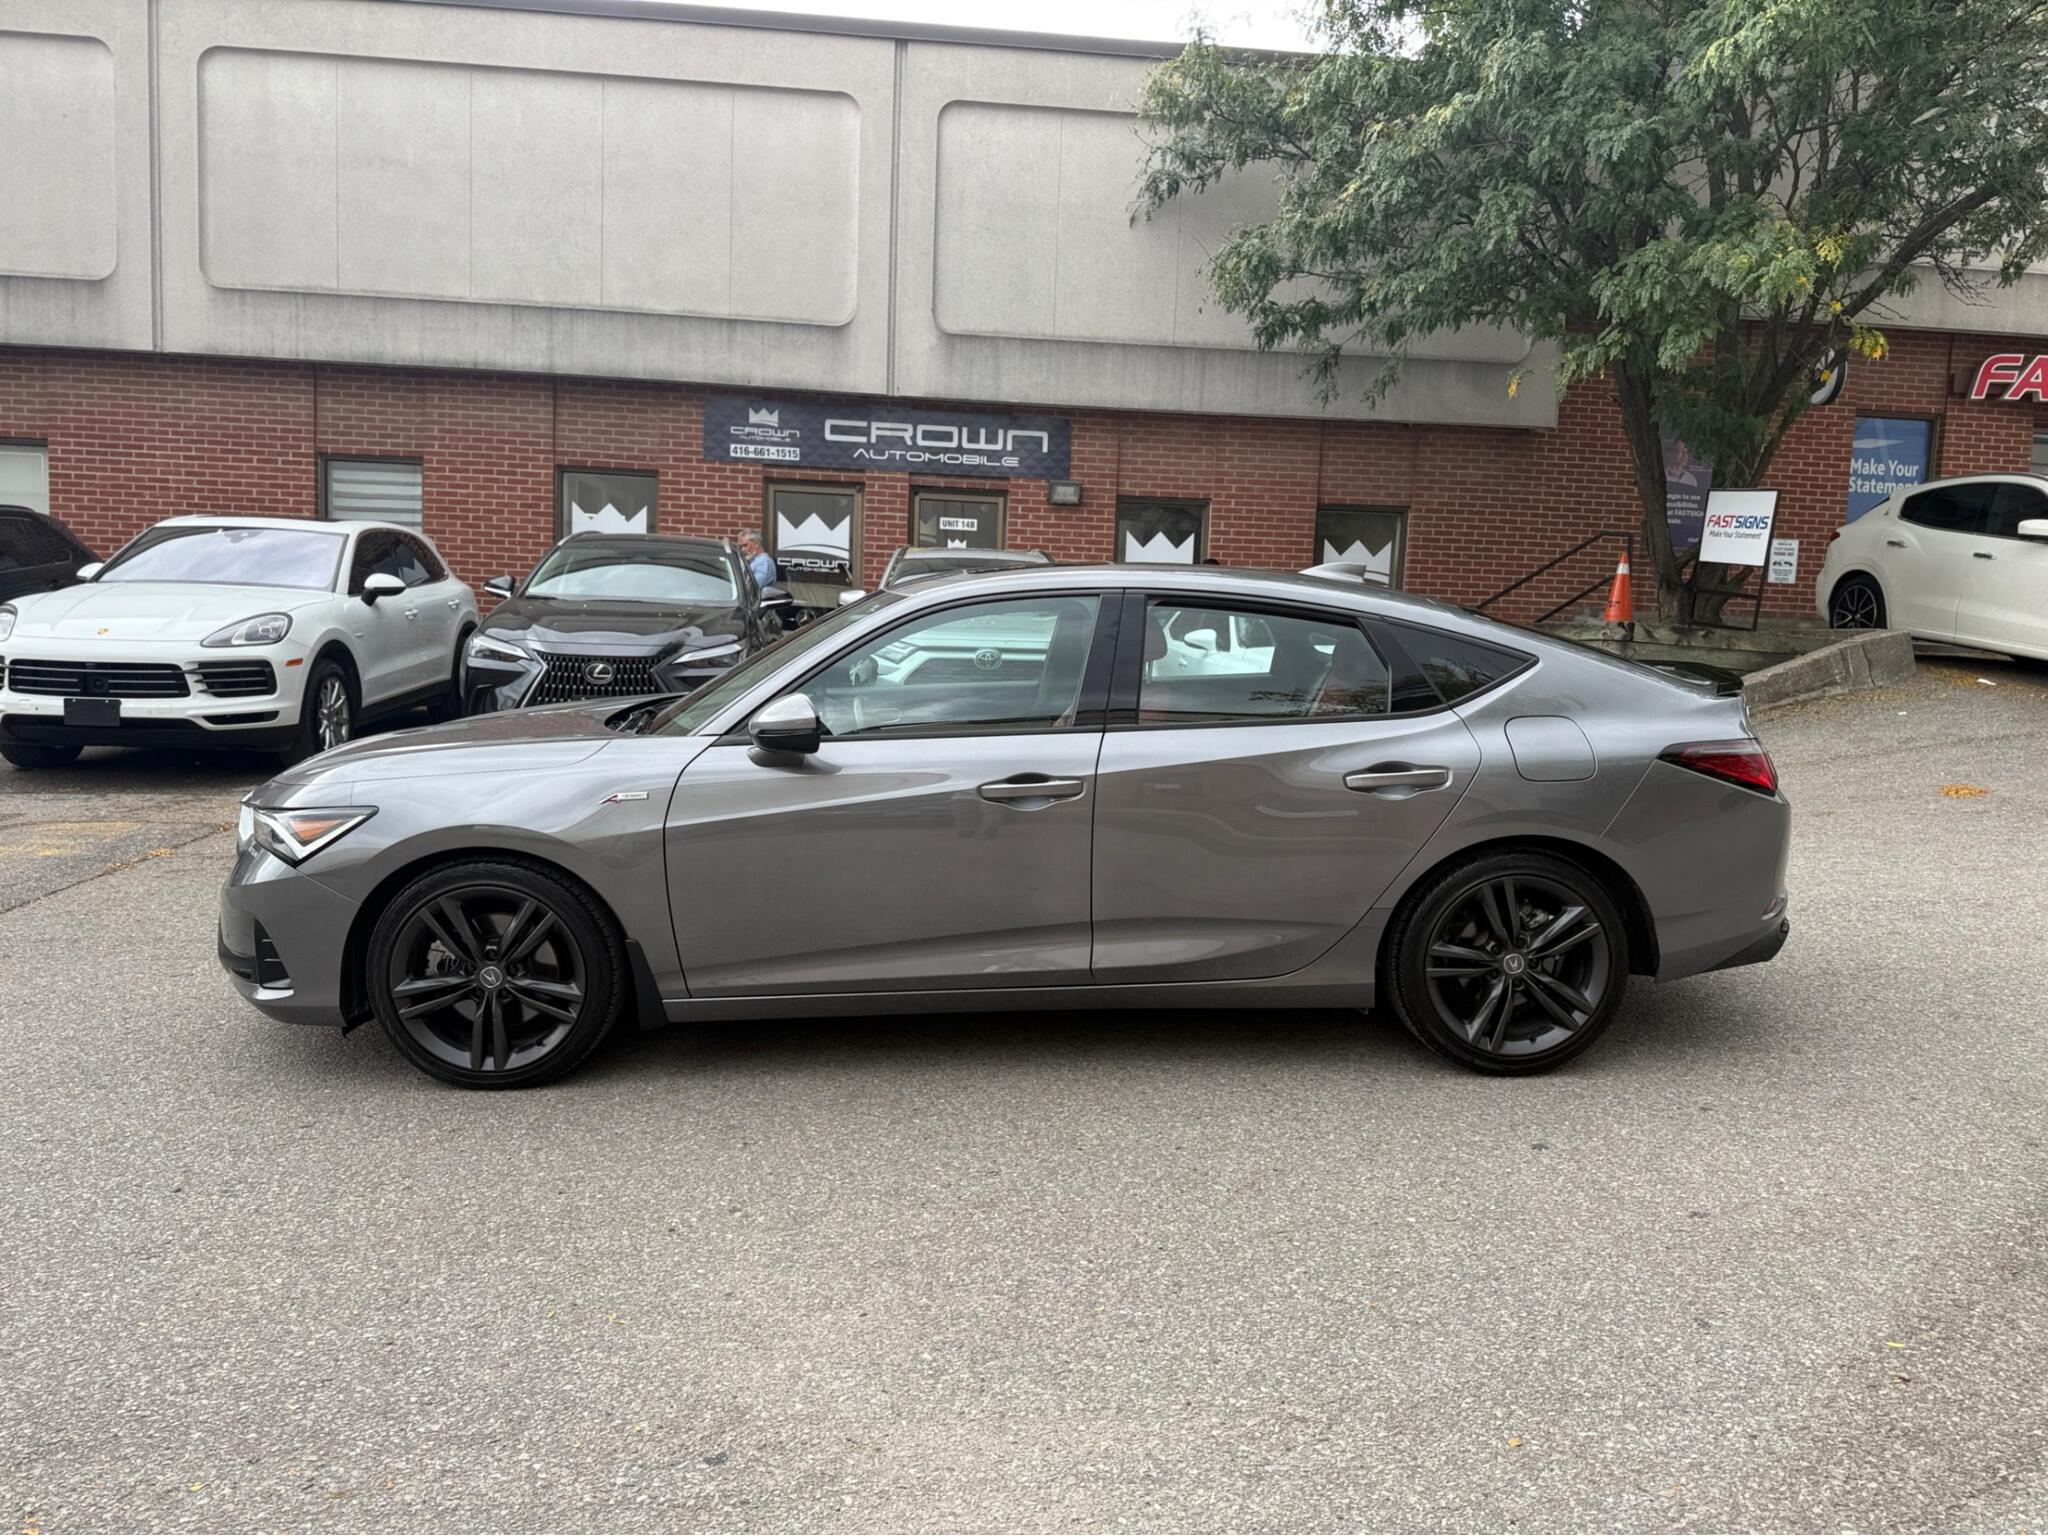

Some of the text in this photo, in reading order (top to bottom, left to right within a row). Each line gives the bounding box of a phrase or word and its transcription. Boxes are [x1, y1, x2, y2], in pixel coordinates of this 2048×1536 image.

[730, 426, 799, 438] CROWN
[824, 418, 1049, 453] CROWN
[731, 445, 799, 459] 416-661-1515
[852, 447, 1020, 467] AUTOMOBILE
[1850, 457, 1919, 477] Make Your
[942, 519, 959, 528] UNIT
[1706, 514, 1770, 530] FASTSIGNS
[1709, 530, 1722, 538] Make
[1734, 531, 1762, 540] Statement
[777, 557, 850, 569] CROWN
